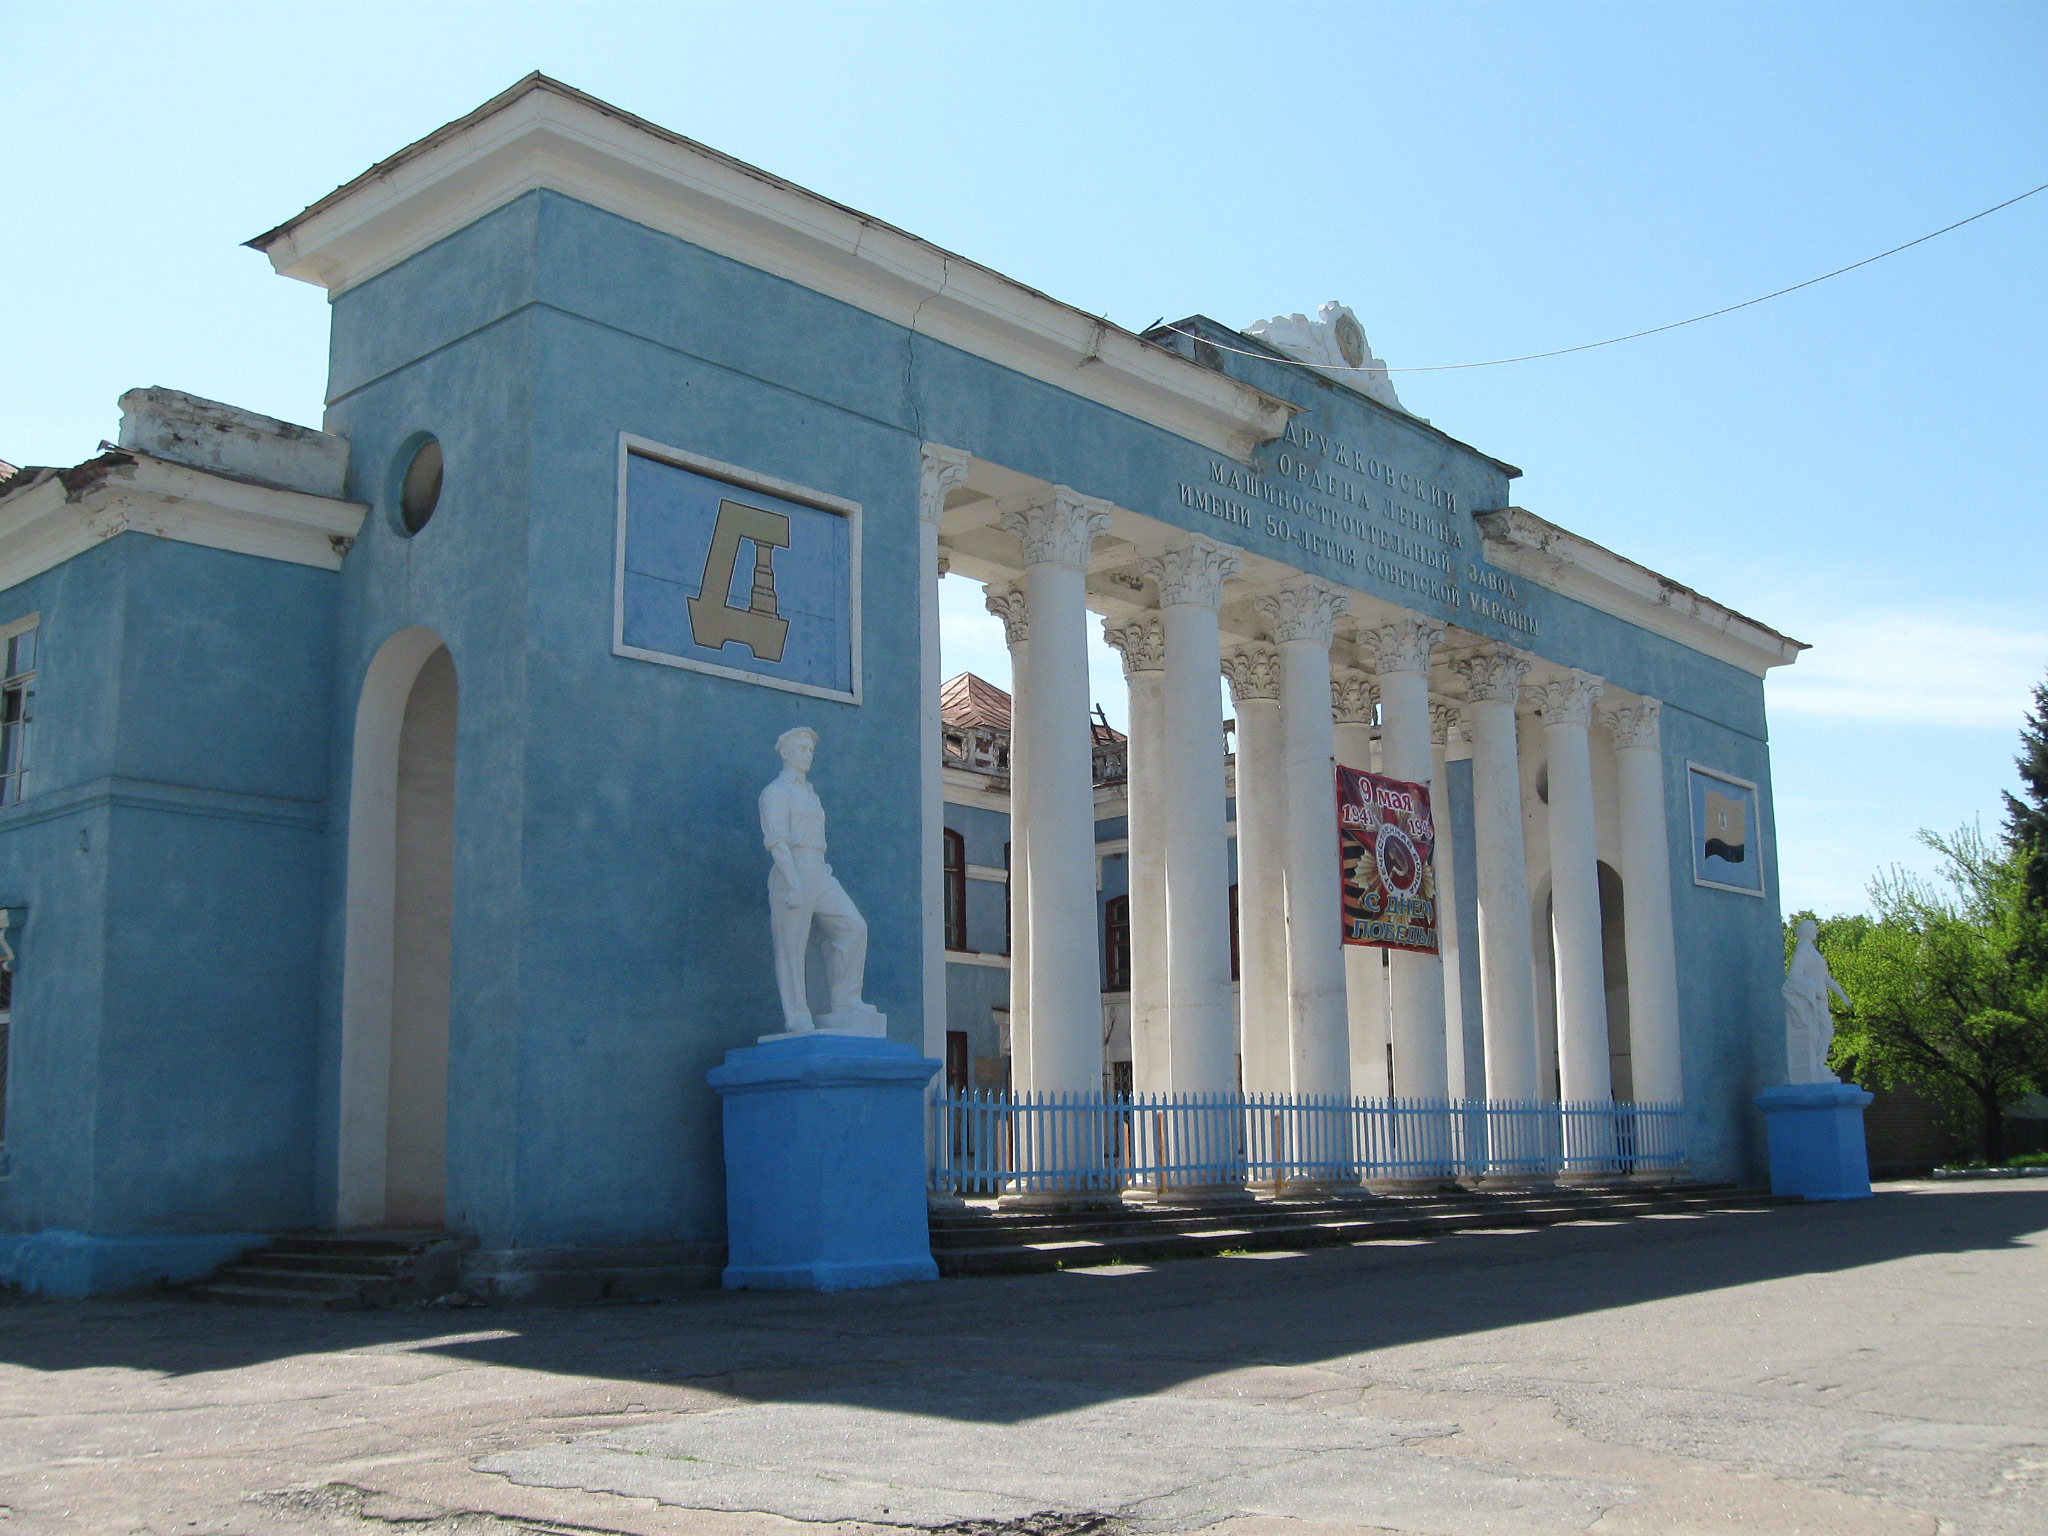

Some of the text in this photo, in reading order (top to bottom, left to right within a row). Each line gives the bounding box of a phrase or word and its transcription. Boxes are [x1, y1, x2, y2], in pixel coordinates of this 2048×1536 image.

[1209, 460, 1517, 601] МАШИНОСТРОИТЕЛЬНЫЙ ЗАВОД
[1279, 454, 1462, 548] ОРДЕНА ЛЕНИНА
[1178, 482, 1539, 637] ИМЕНИ 50-ЛЕТИЯ СОВЕТСКОЙ УКРАИНЫ
[1342, 803, 1375, 826] 1941
[1359, 777, 1414, 813] 9 мая
[1364, 891, 1381, 912] С
